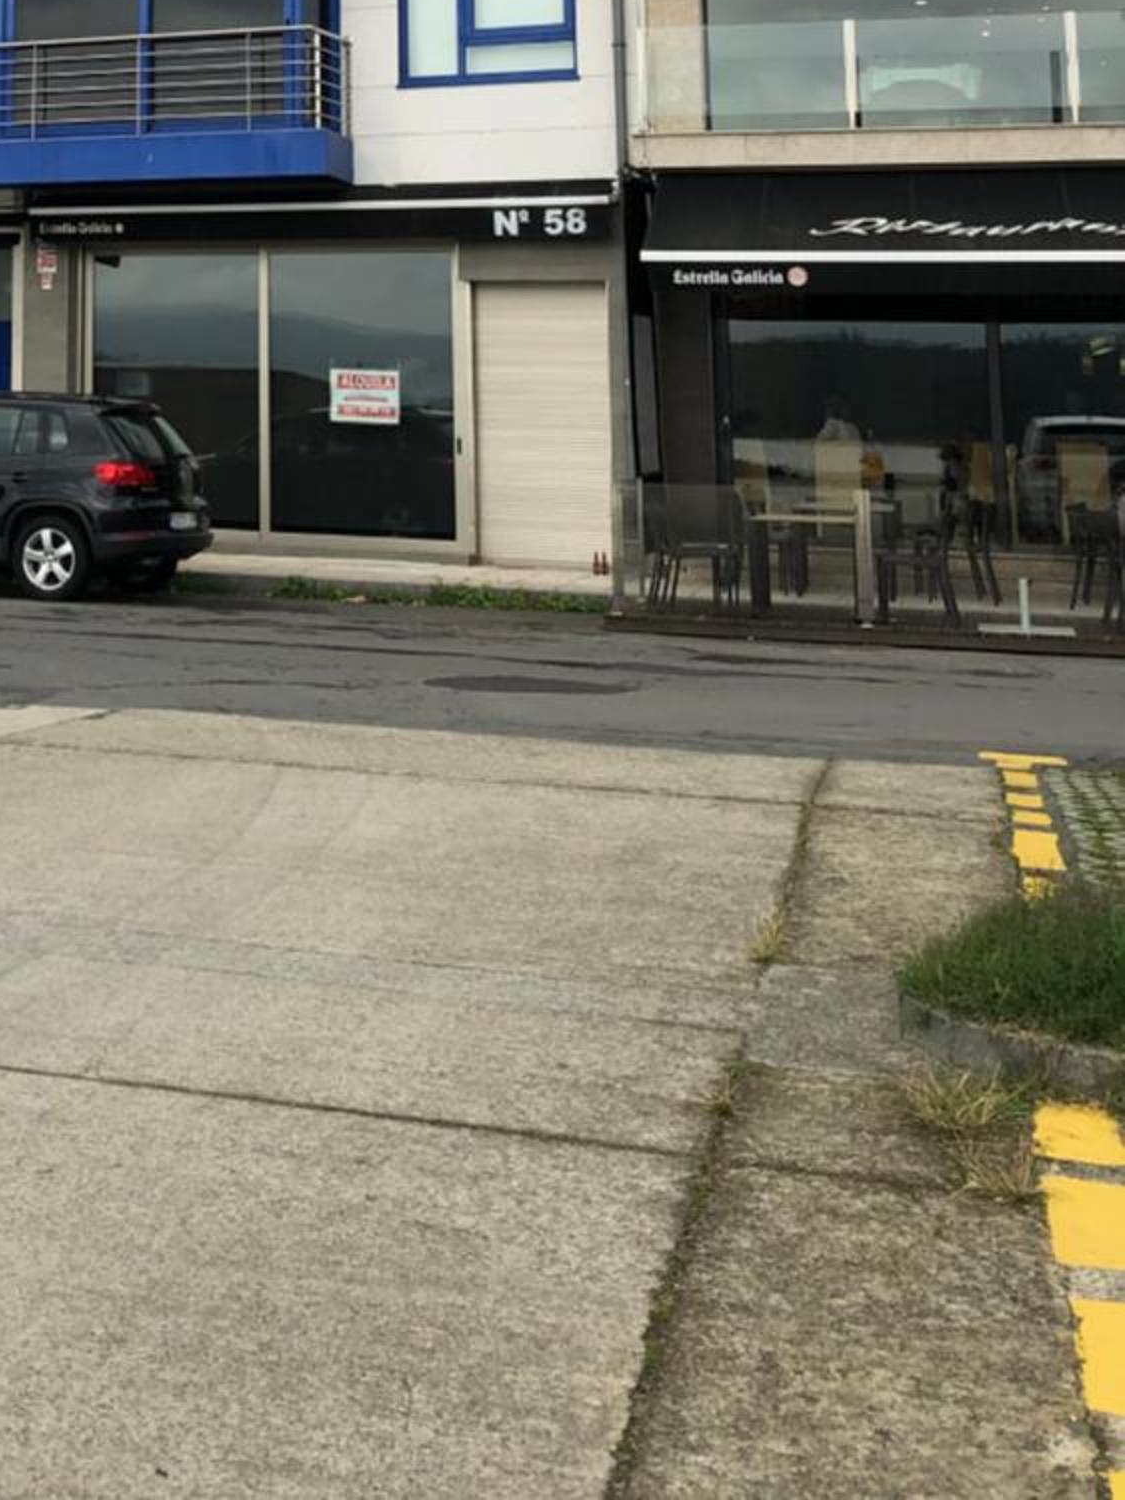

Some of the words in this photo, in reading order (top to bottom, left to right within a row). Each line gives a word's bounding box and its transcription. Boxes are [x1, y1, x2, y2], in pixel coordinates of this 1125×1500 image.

[543, 207, 587, 235] 58
[808, 217, 1125, 237] Restauran
[673, 269, 730, 285] Estrella
[731, 269, 785, 285] Galicia
